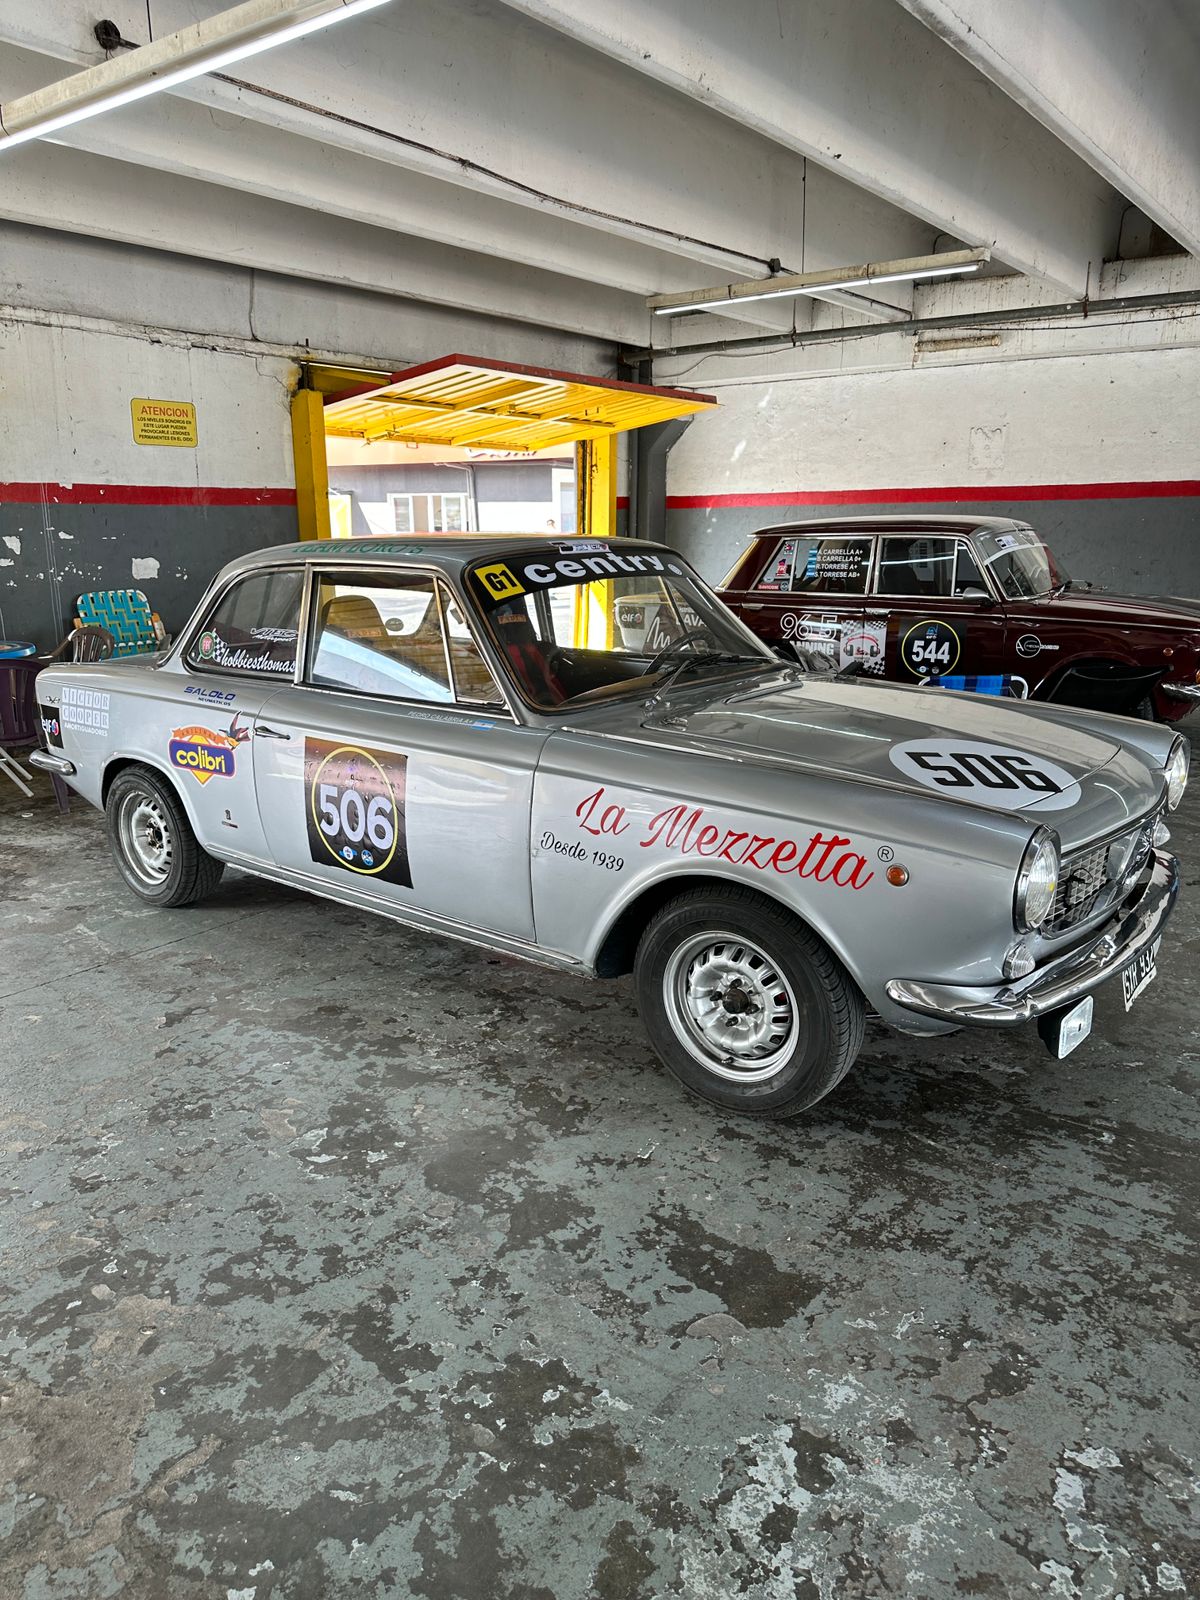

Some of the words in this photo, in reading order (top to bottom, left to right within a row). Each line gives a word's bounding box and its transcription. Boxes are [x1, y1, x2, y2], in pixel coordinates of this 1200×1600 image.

[141, 405, 188, 418] ATENCION
[485, 568, 517, 592] G1
[523, 552, 665, 584] centry
[621, 614, 635, 622] elf
[911, 640, 950, 664] 544
[62, 687, 110, 710] VICTOR
[62, 705, 109, 729] COOPER
[64, 722, 108, 737] AMORTIGUADORES
[176, 746, 226, 773] colibri
[904, 751, 1063, 792] 506
[320, 783, 394, 850] 506
[541, 831, 588, 861] Desde
[592, 851, 624, 871] 1939
[576, 788, 630, 835] La
[639, 804, 874, 890] Mezzetta
[1140, 945, 1155, 978] 932
